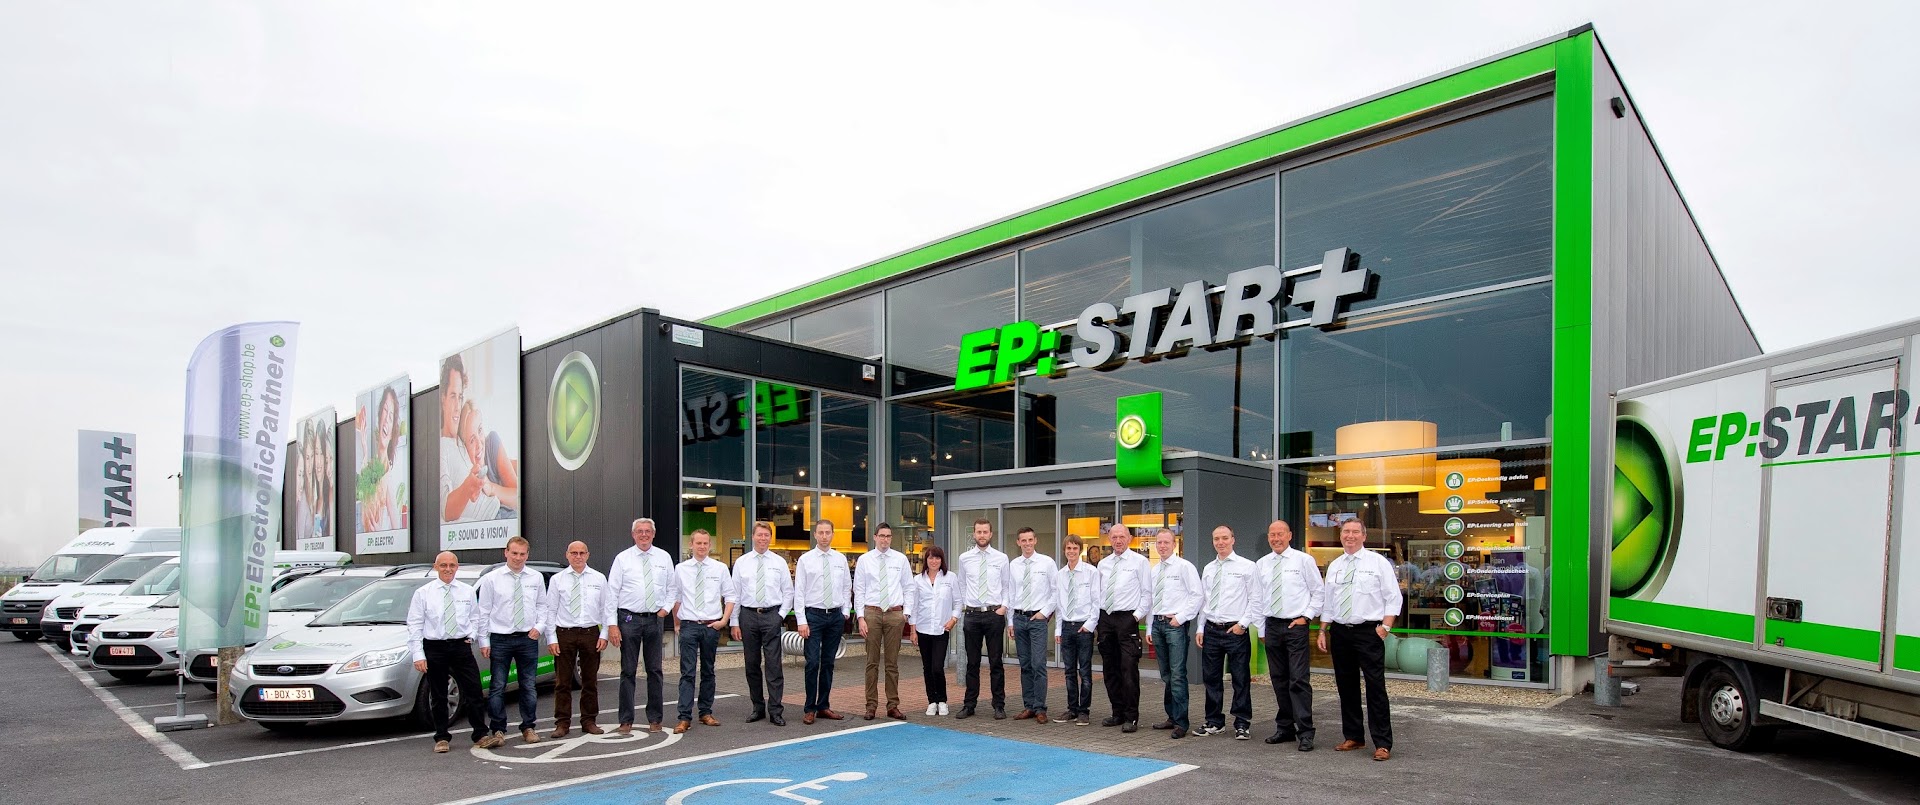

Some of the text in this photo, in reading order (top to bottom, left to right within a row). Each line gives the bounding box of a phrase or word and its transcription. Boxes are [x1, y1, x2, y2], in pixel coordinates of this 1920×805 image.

[954, 320, 1061, 391] EP:
[238, 343, 257, 440] www.ep-shop.be
[243, 350, 285, 630] EP:ElectronicPartner
[375, 535, 394, 546] ELECTRO
[459, 528, 479, 540] SOUND
[480, 528, 485, 539] &
[486, 526, 509, 539] VISION
